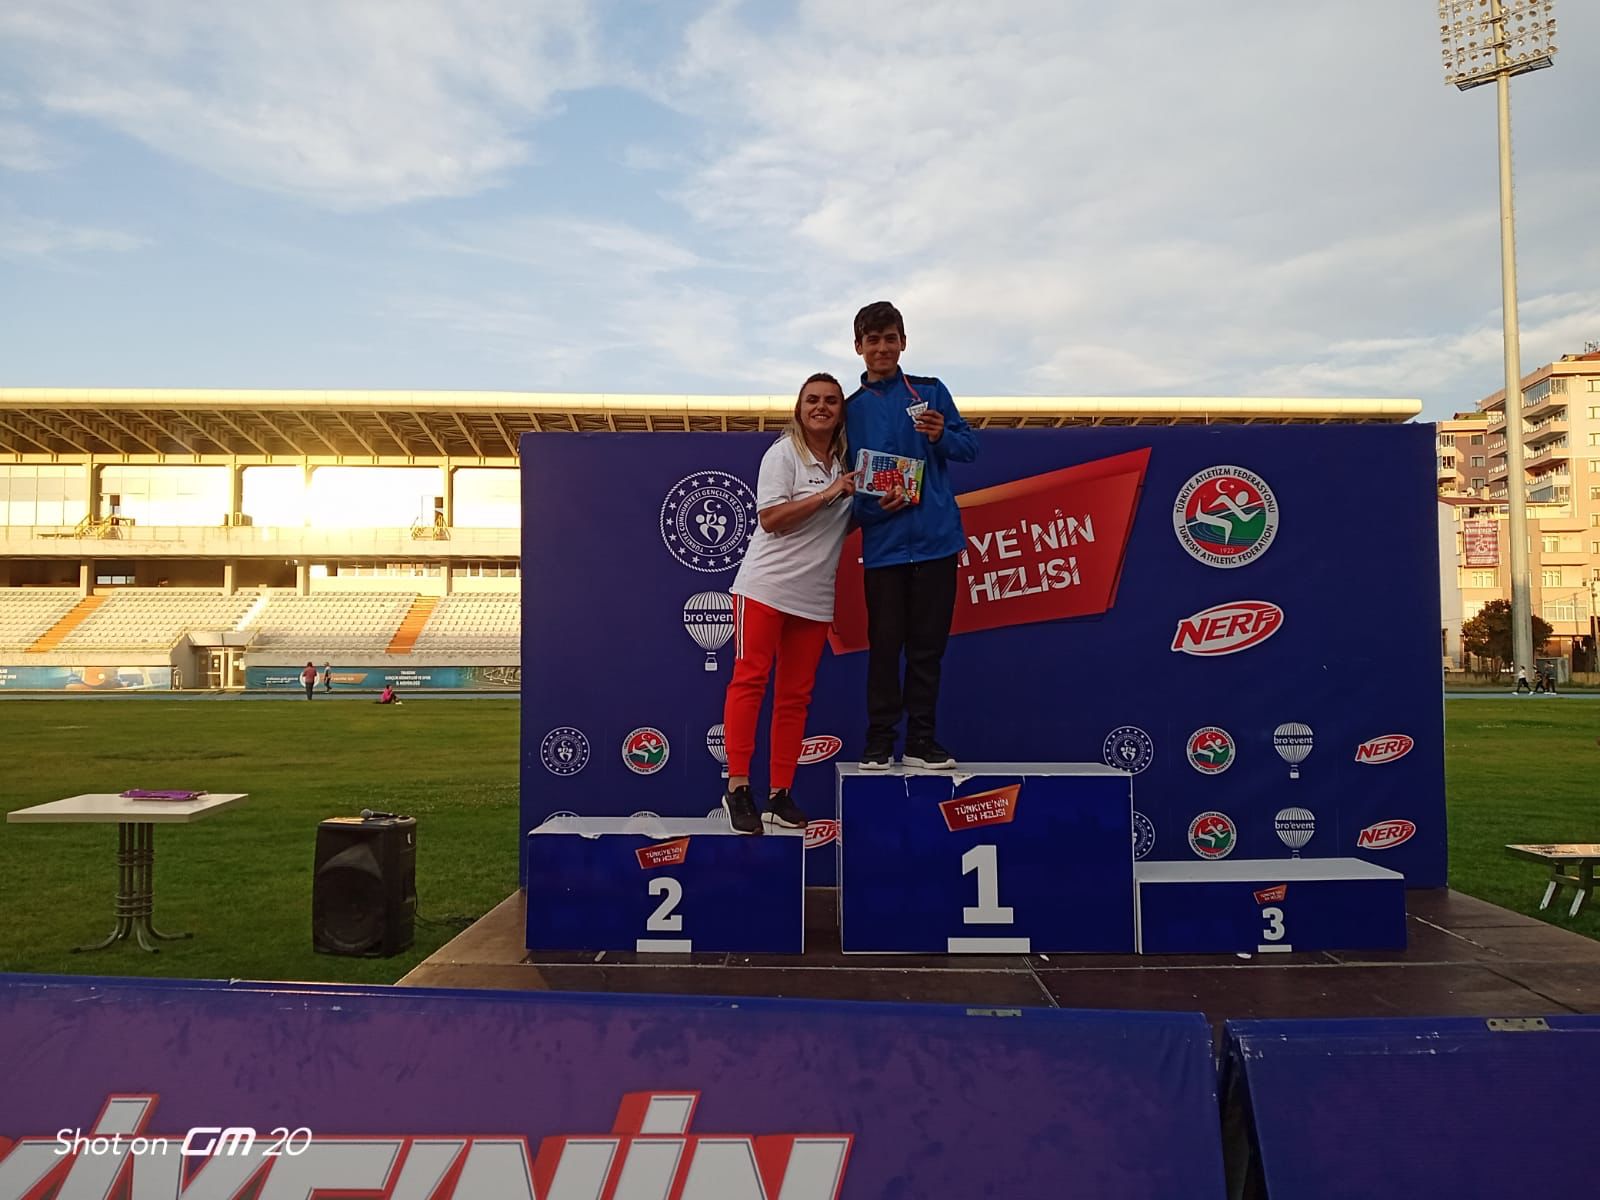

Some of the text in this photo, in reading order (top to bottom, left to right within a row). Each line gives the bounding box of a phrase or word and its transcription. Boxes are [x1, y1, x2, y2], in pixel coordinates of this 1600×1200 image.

[1176, 466, 1277, 514] TÜRKİYE ATLETİZM FEDERASYONU
[1178, 524, 1274, 565] TURKISH ATHLETIC FEDERATION
[1220, 547, 1235, 555] 1922
[683, 610, 734, 622] bro'even
[1173, 605, 1279, 651] NERF
[801, 739, 841, 757] ERF
[1273, 736, 1313, 745] bro'event
[1356, 738, 1411, 761] NERF
[804, 825, 839, 841] ERF
[1274, 820, 1315, 830] bro'event
[1358, 823, 1412, 846] NERF
[962, 845, 1013, 924] 1
[647, 877, 682, 931] 2
[1262, 907, 1285, 941] 3
